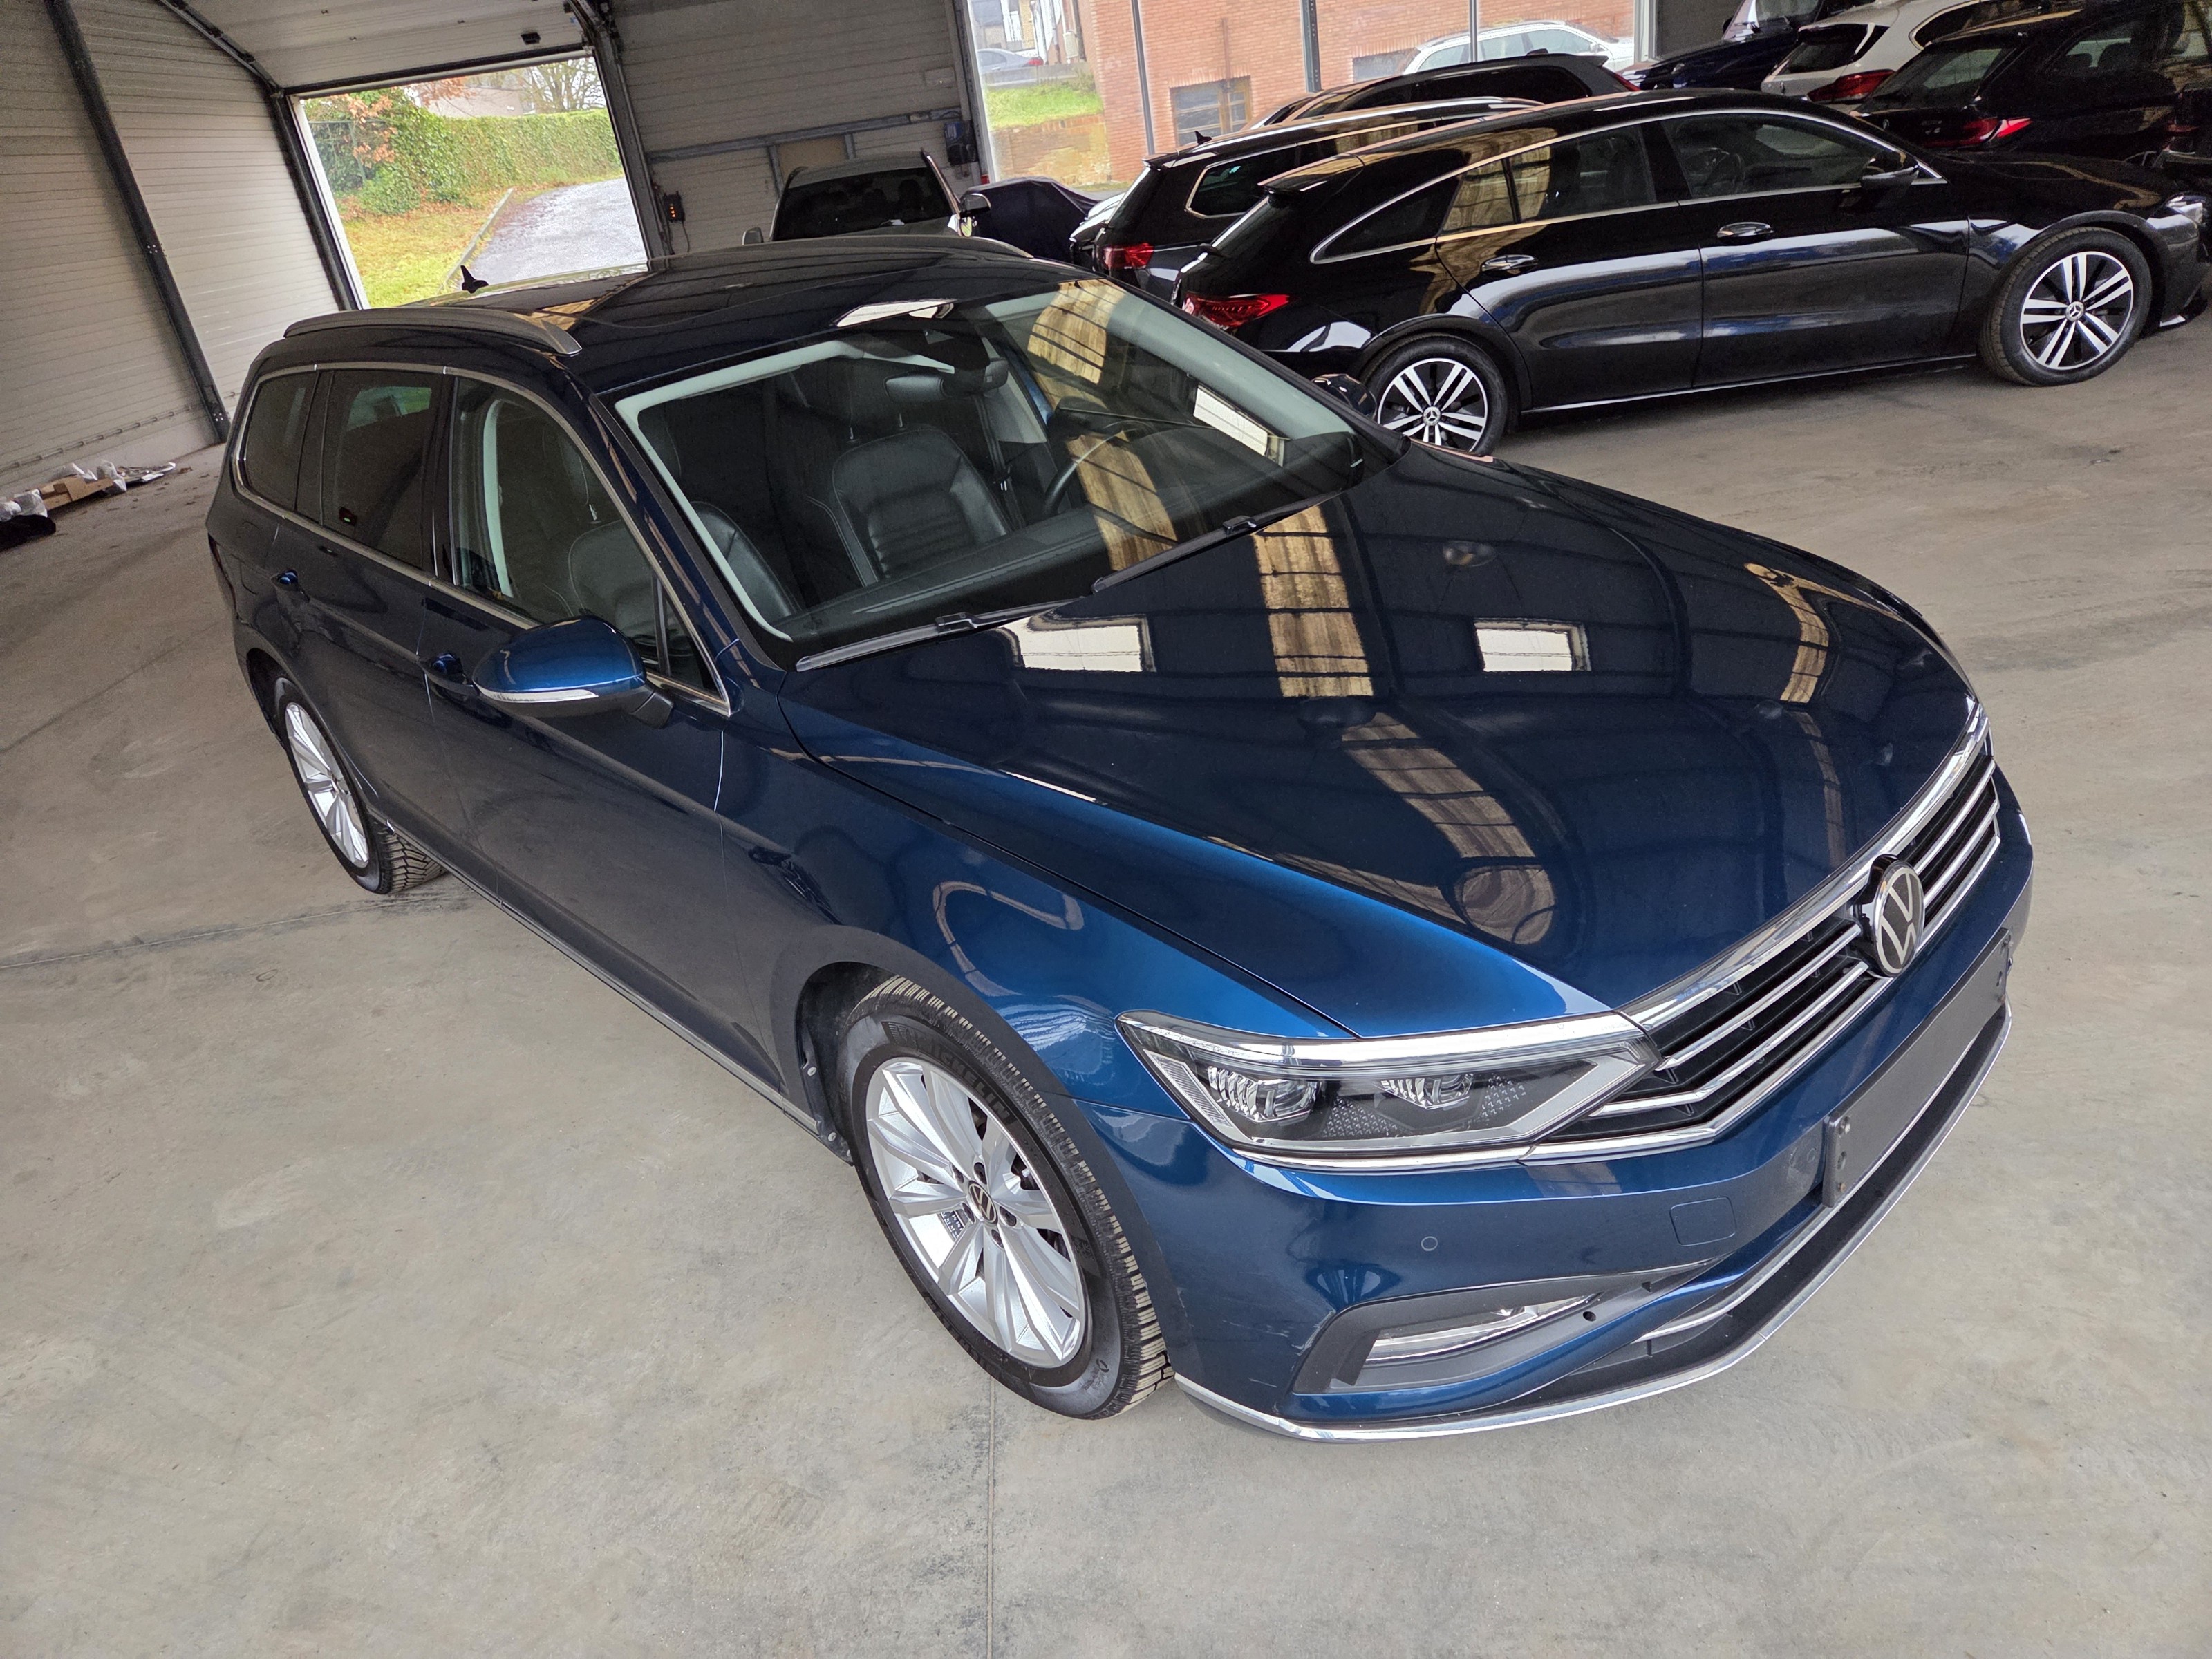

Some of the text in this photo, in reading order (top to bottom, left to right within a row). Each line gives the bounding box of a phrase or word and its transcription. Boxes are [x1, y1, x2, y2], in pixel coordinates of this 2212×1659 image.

[1878, 869, 1921, 971] VW
[916, 1034, 1011, 1119] MICHELIN
[969, 1184, 995, 1221] VW
